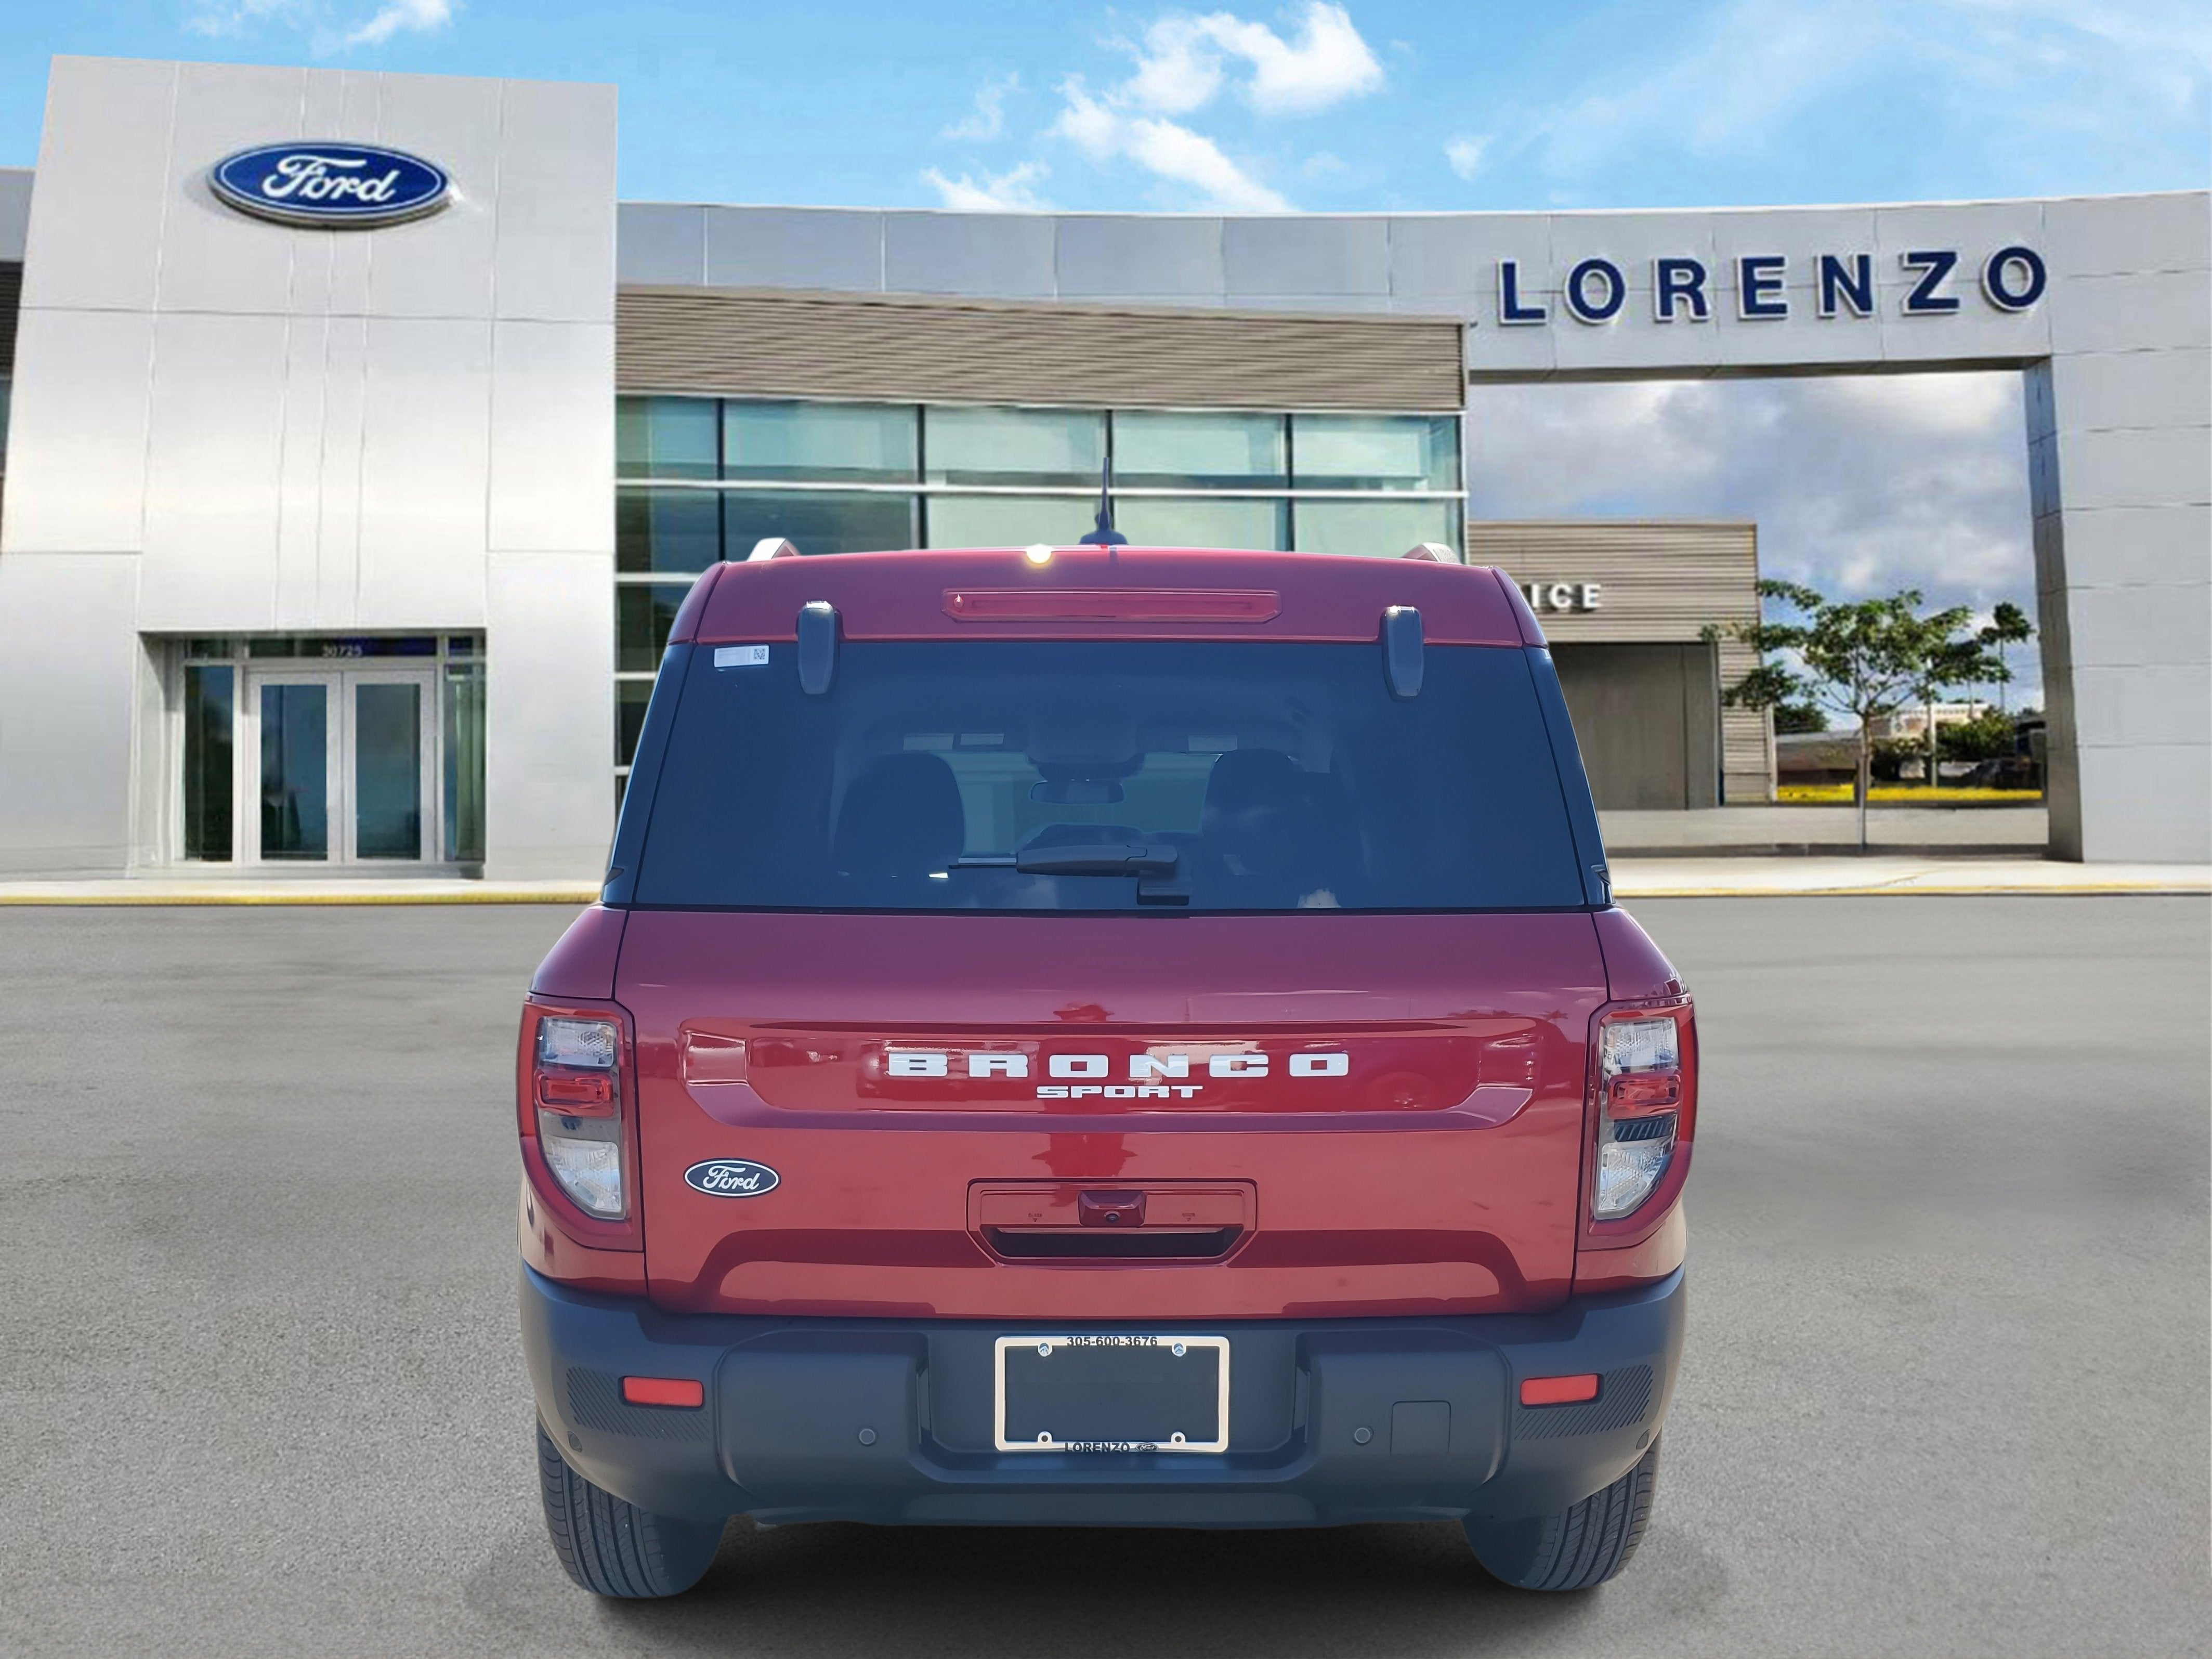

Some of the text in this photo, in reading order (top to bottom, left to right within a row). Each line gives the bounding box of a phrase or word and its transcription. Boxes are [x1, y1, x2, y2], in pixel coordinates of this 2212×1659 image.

[262, 155, 400, 202] Ford
[1497, 245, 2048, 325] LORENZO
[1530, 583, 1602, 609] ICE
[887, 1052, 1350, 1078] BRONCO
[1036, 1085, 1203, 1099] SPORT
[703, 1165, 761, 1190] Ford
[1066, 1336, 1158, 1347] 305-600-3676
[1064, 1442, 1130, 1453] LORENZO
